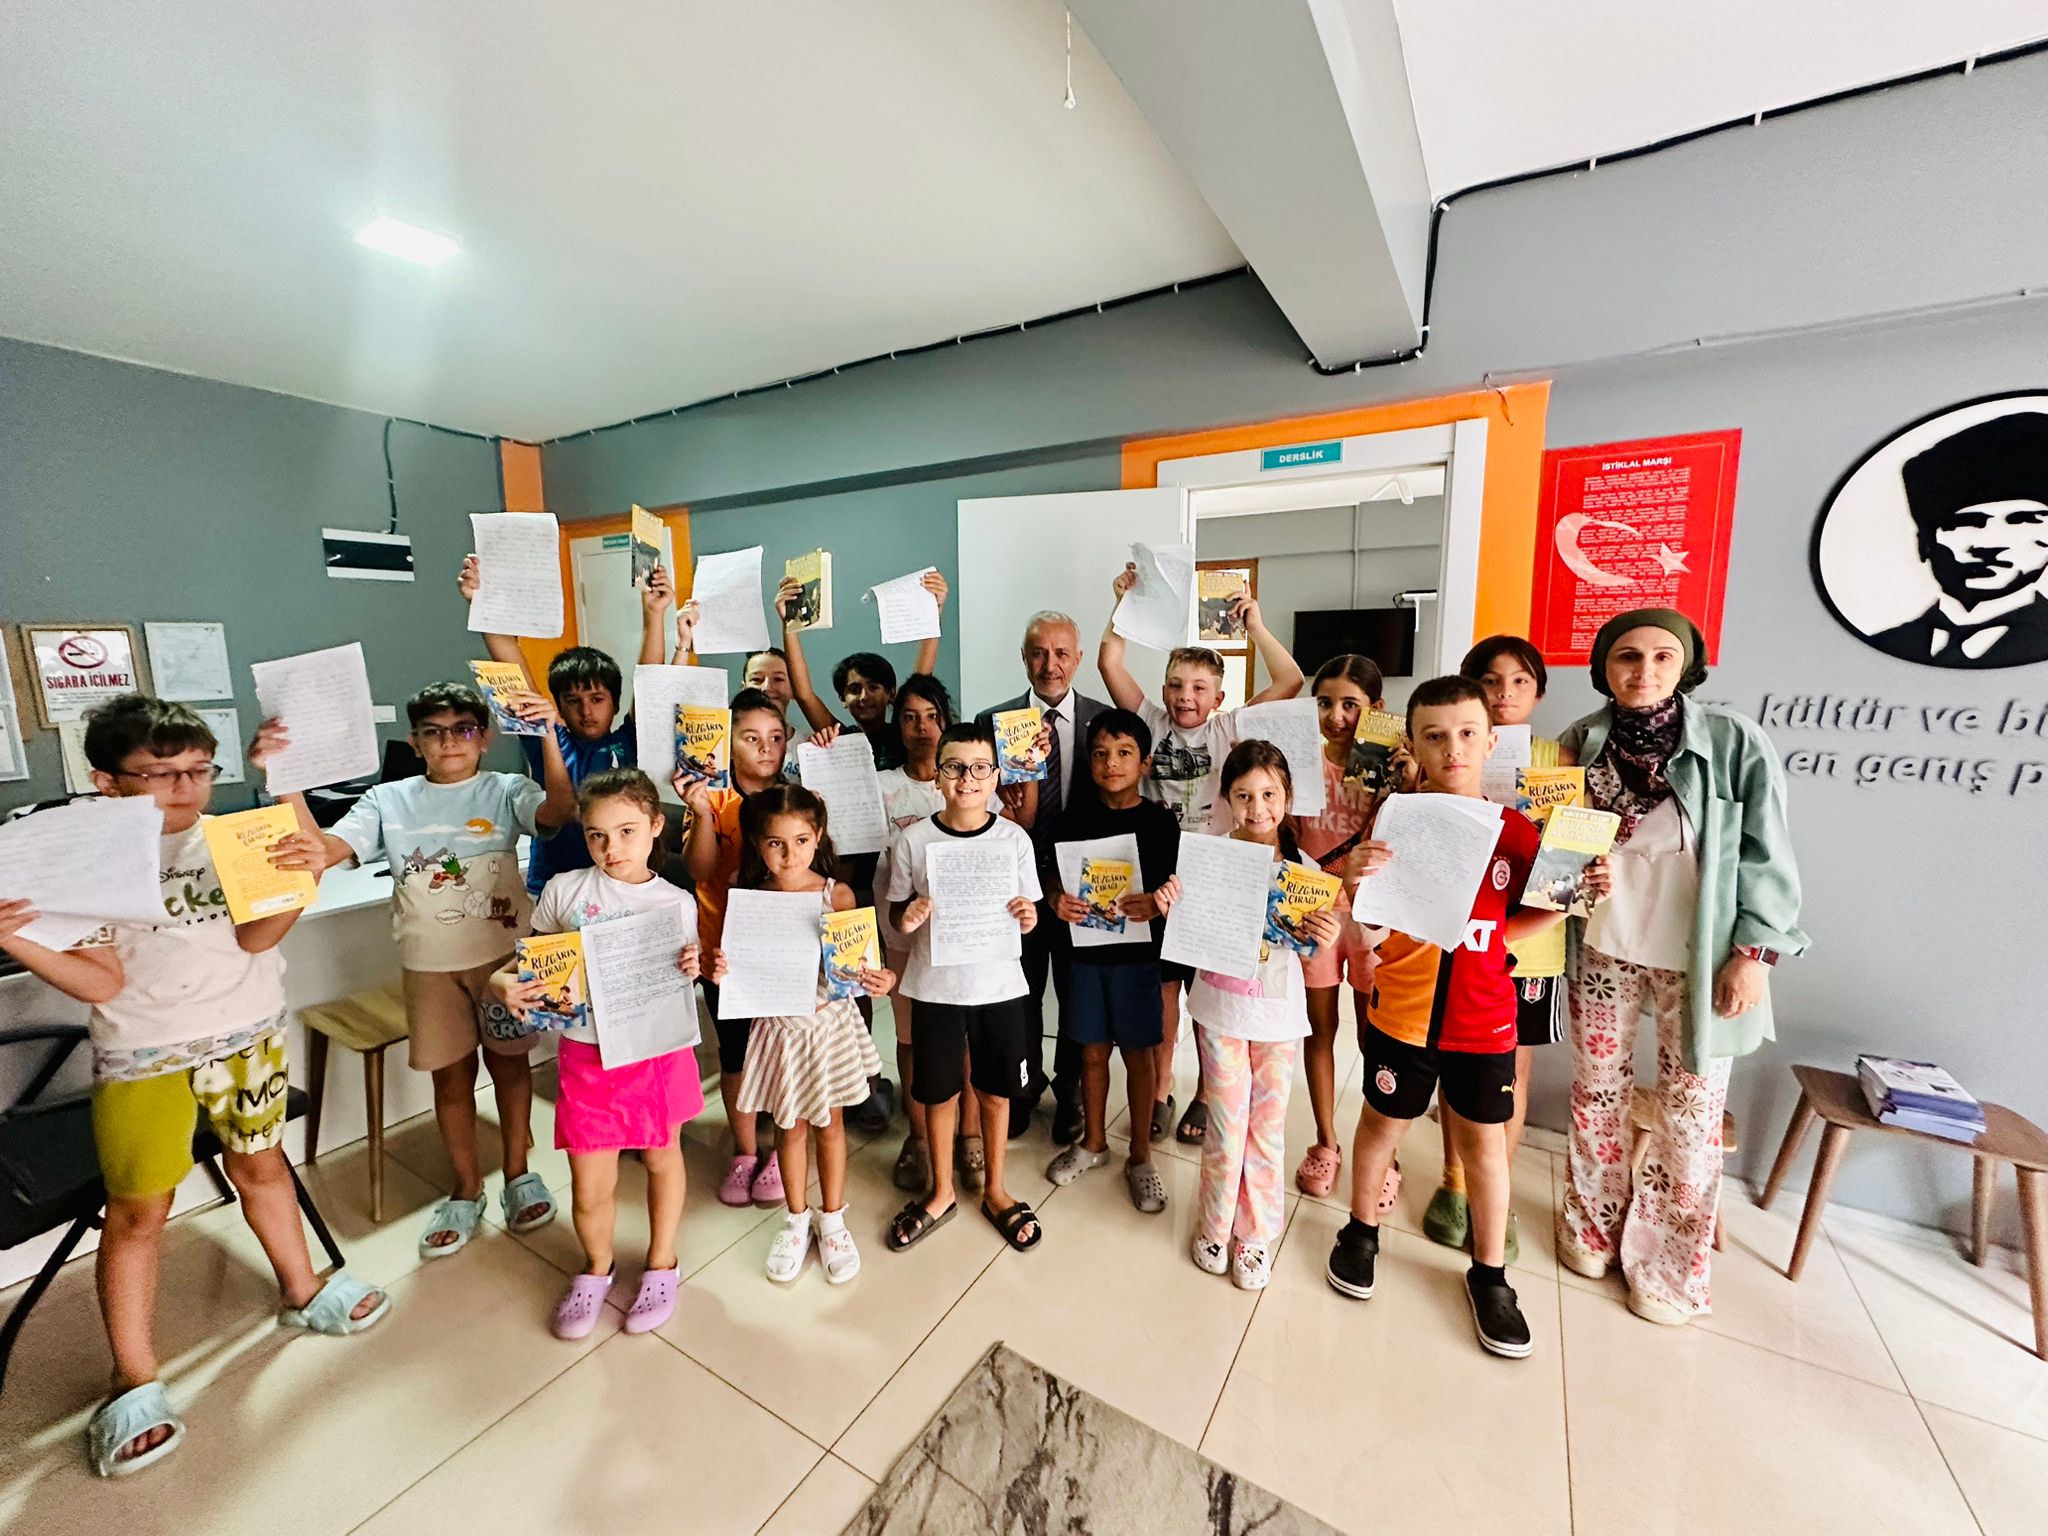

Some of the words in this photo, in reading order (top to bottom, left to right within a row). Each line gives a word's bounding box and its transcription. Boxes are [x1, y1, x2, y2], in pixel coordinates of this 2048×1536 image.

[1279, 449, 1324, 463] DERSLİK
[1757, 693, 1907, 731] kültür
[1921, 703, 1981, 734] ve
[1784, 749, 1839, 777] en
